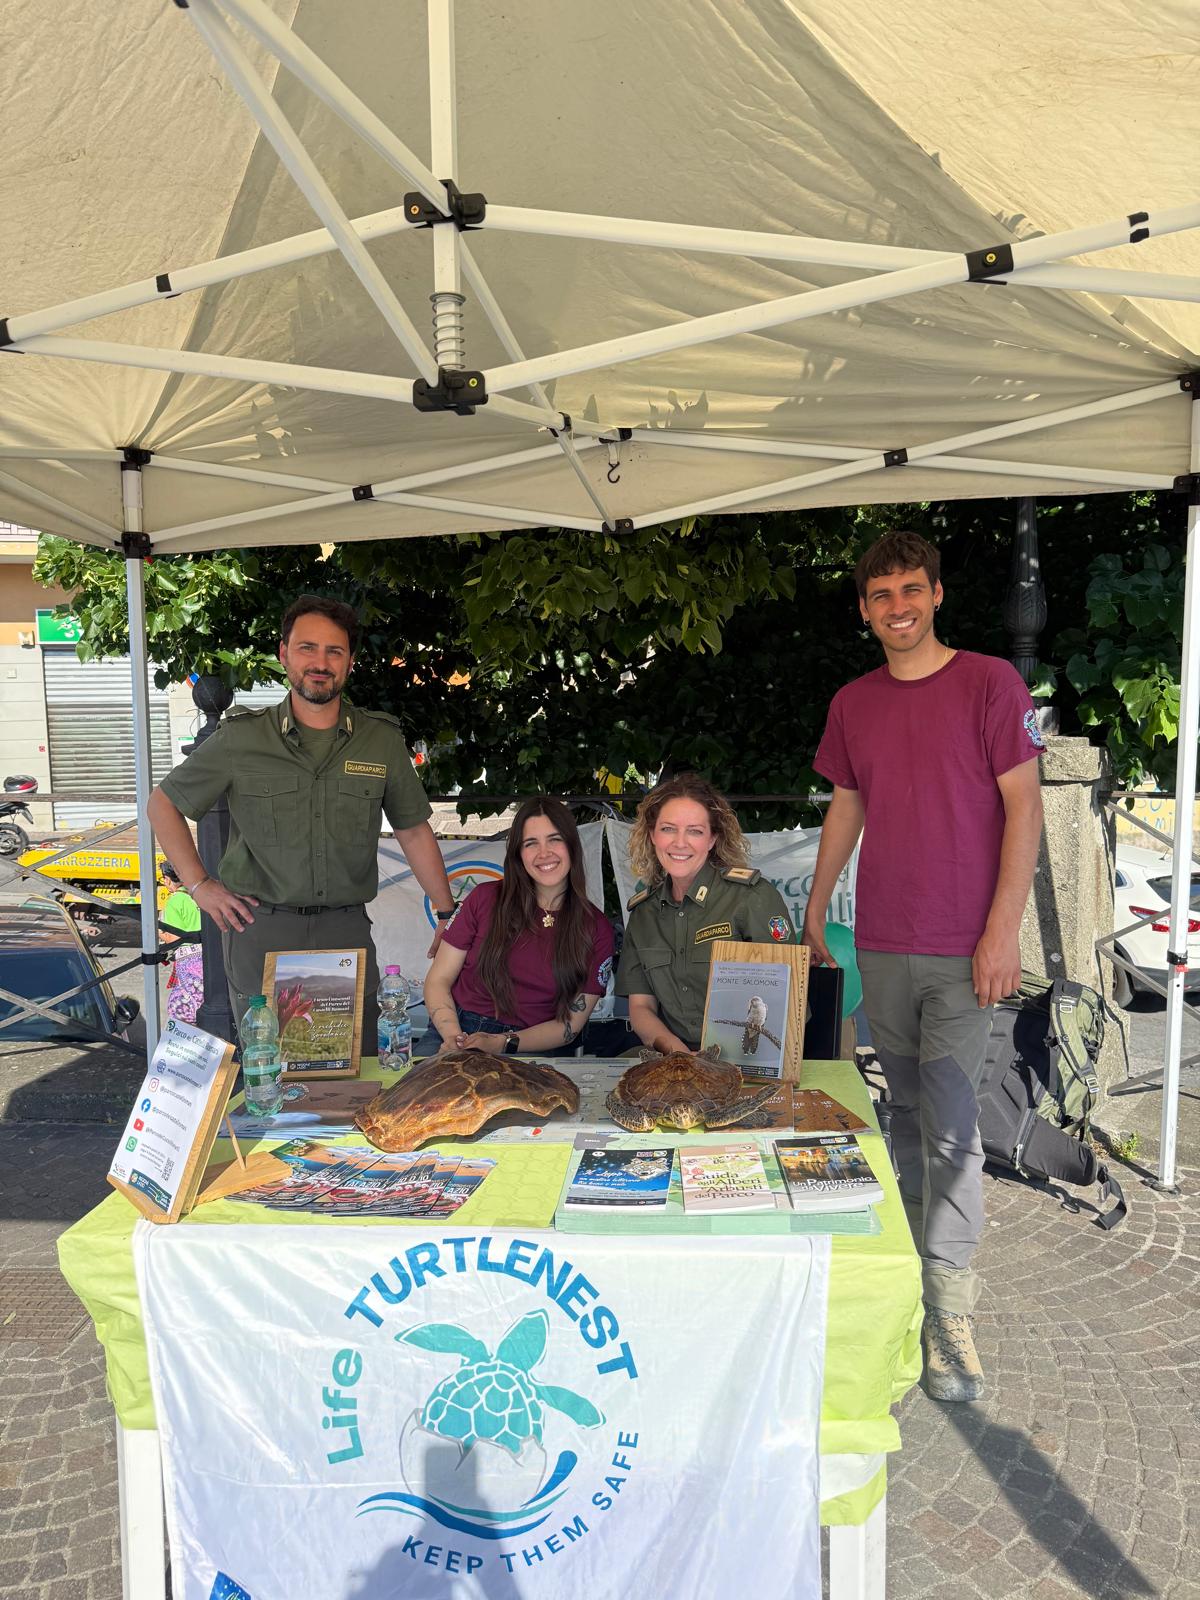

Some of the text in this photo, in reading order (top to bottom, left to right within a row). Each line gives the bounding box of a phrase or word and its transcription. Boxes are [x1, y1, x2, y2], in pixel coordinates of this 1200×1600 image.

[54, 856, 131, 868] ARROZZERIA
[771, 873, 816, 897] rco
[742, 978, 780, 987] SALOMONE
[692, 1172, 739, 1180] Guida
[715, 1177, 761, 1185] Alberi
[793, 1180, 807, 1188] Un
[707, 1184, 763, 1193] Arbusti
[813, 1183, 864, 1192] Vivere
[321, 1236, 638, 1465] Life TURTLENEST
[401, 1431, 639, 1575] KEEP THEM SAFE
